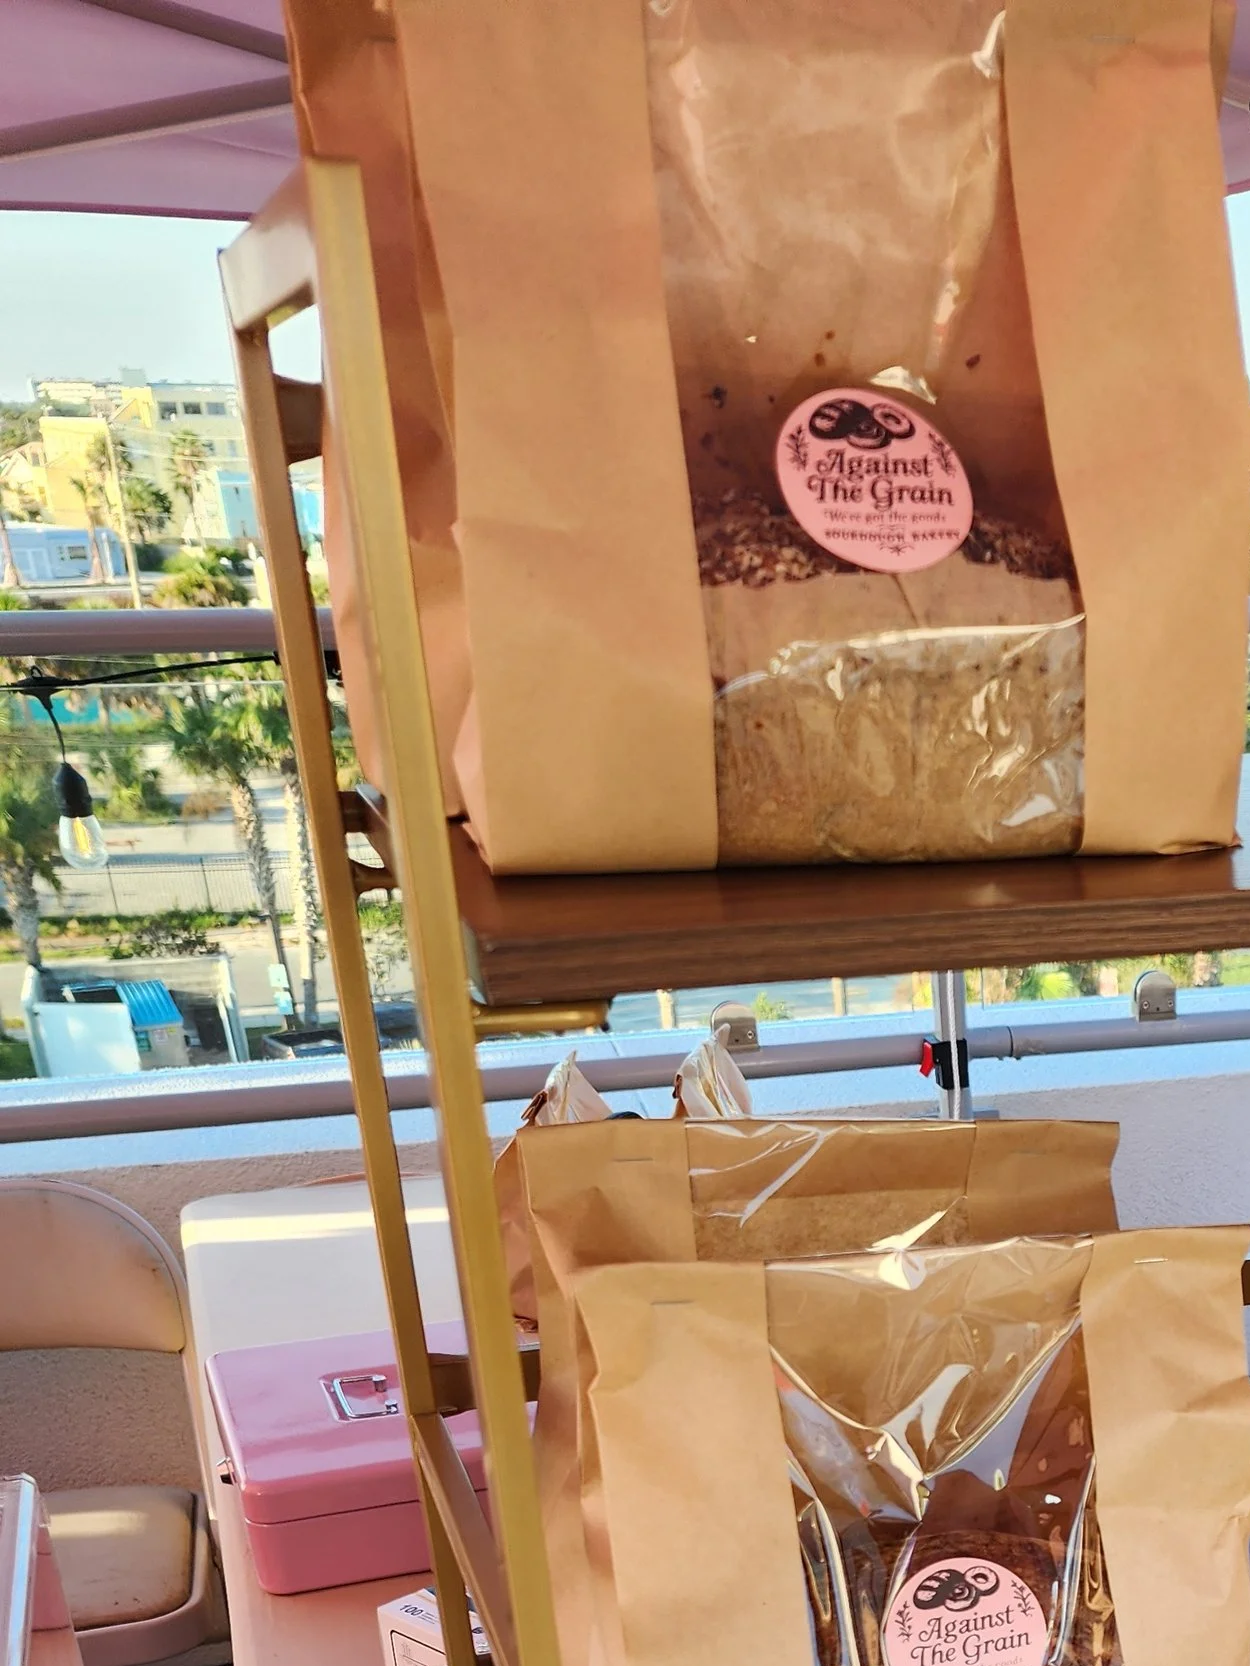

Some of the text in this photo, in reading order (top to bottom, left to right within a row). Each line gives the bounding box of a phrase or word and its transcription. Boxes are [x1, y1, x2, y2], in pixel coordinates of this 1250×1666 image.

[815, 448, 931, 482] Against
[807, 474, 954, 511] The Grain
[400, 1604, 424, 1617] 100
[918, 1605, 1014, 1643] Against
[962, 1629, 1032, 1665] Grain
